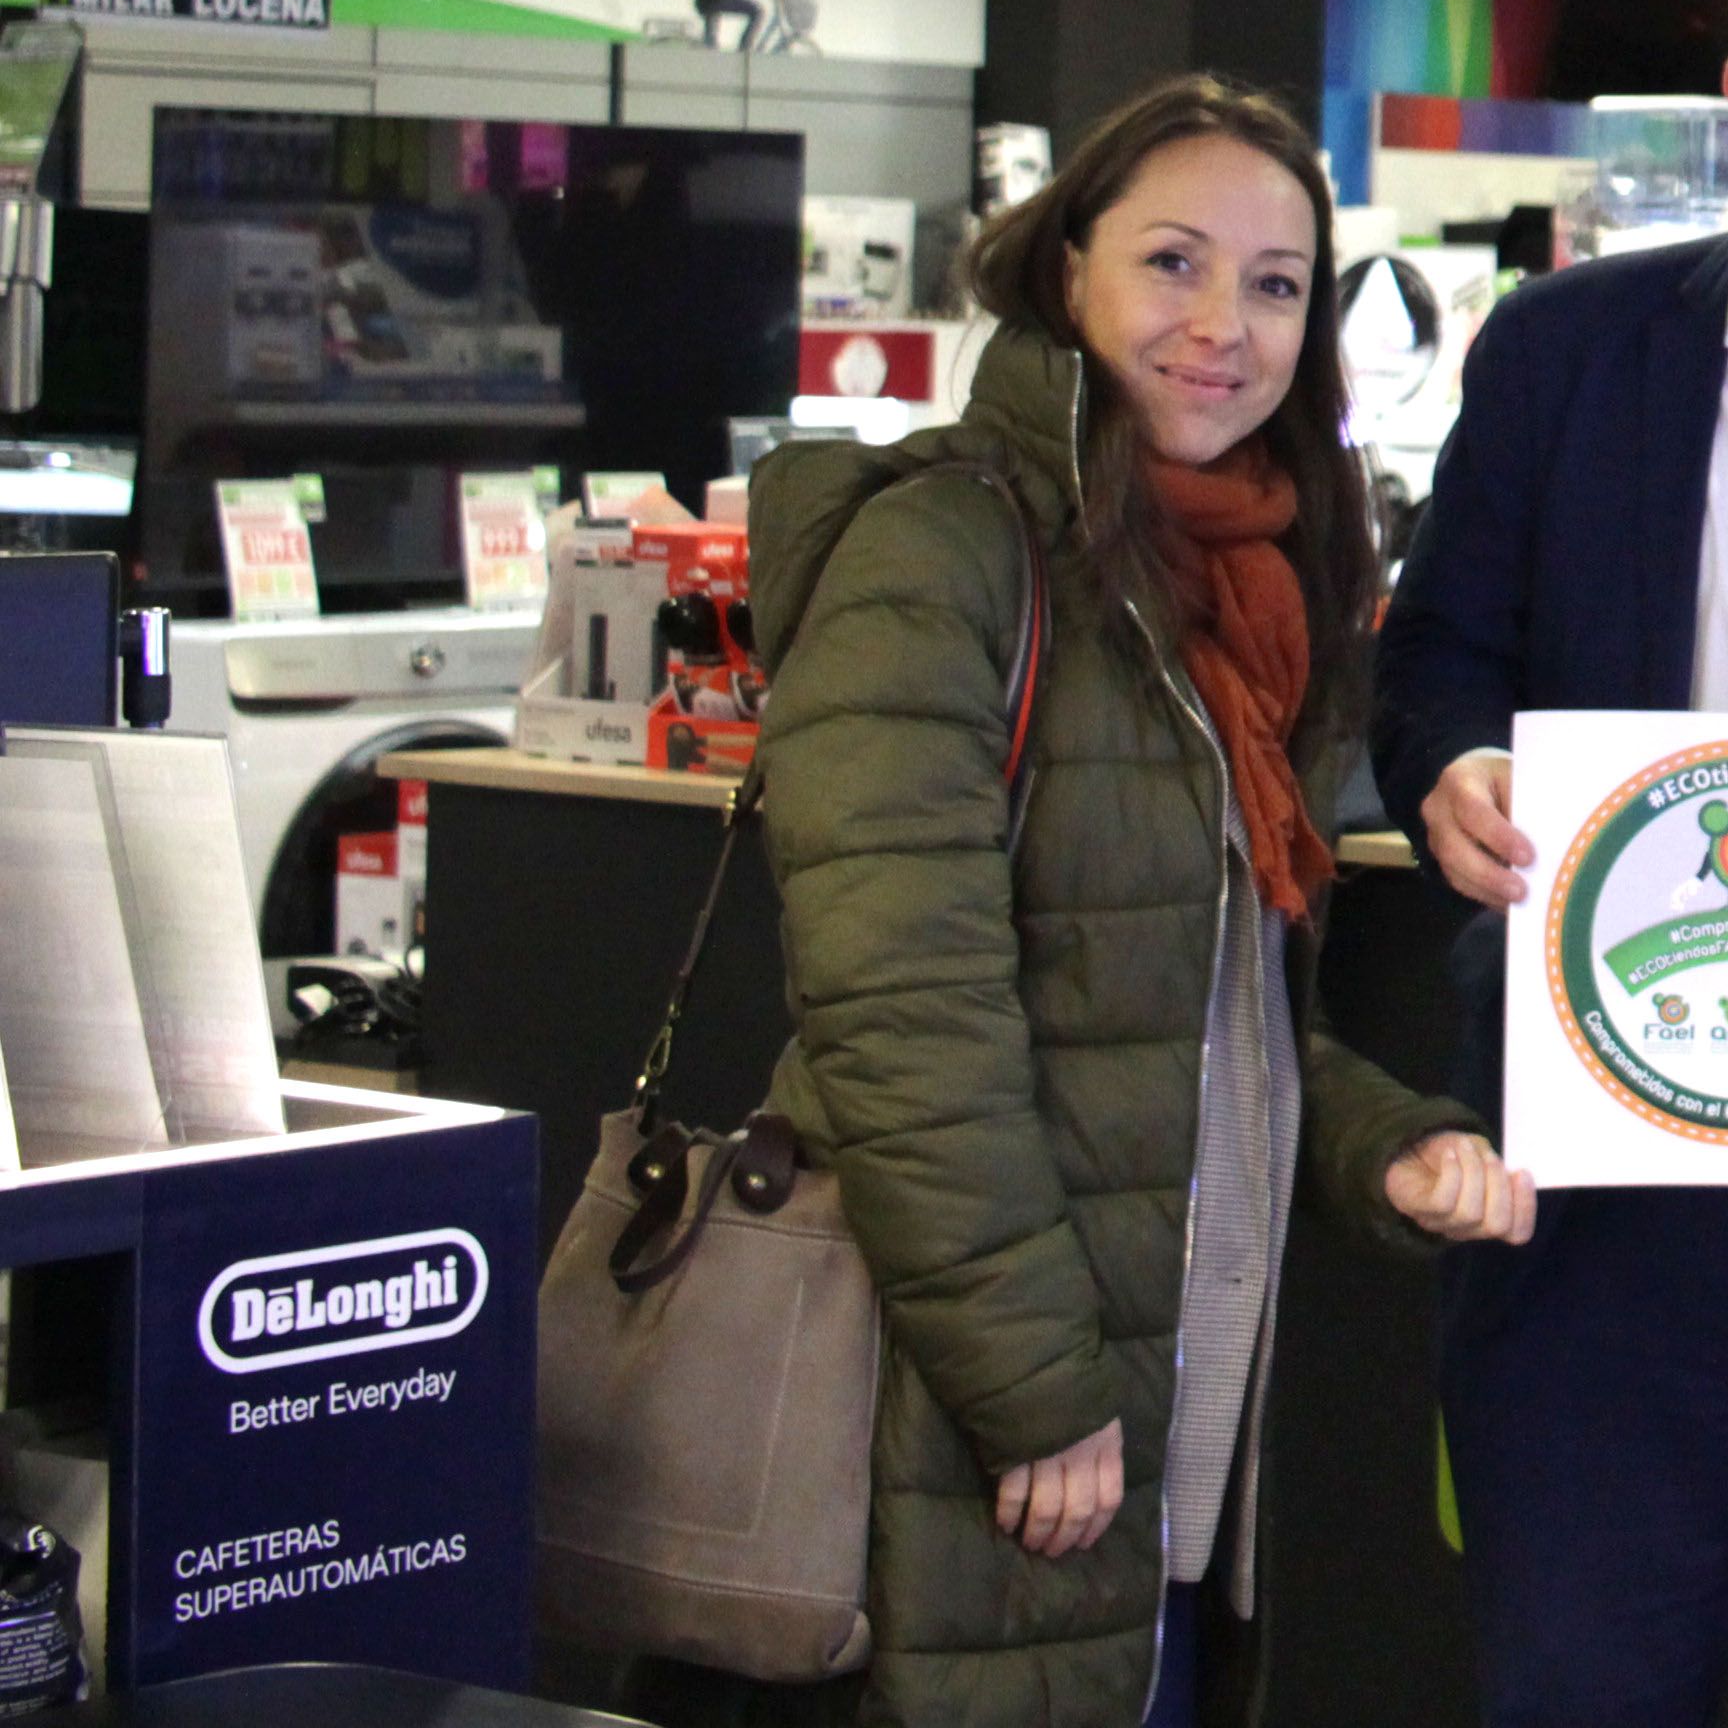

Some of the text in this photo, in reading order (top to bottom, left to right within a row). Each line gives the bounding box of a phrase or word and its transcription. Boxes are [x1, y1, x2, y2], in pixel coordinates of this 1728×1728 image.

[229, 1368, 457, 1434] Better Everyday
[174, 1519, 341, 1578] CAFETERAS
[174, 1534, 467, 1622] SUPERAUTOMÁTICAS
